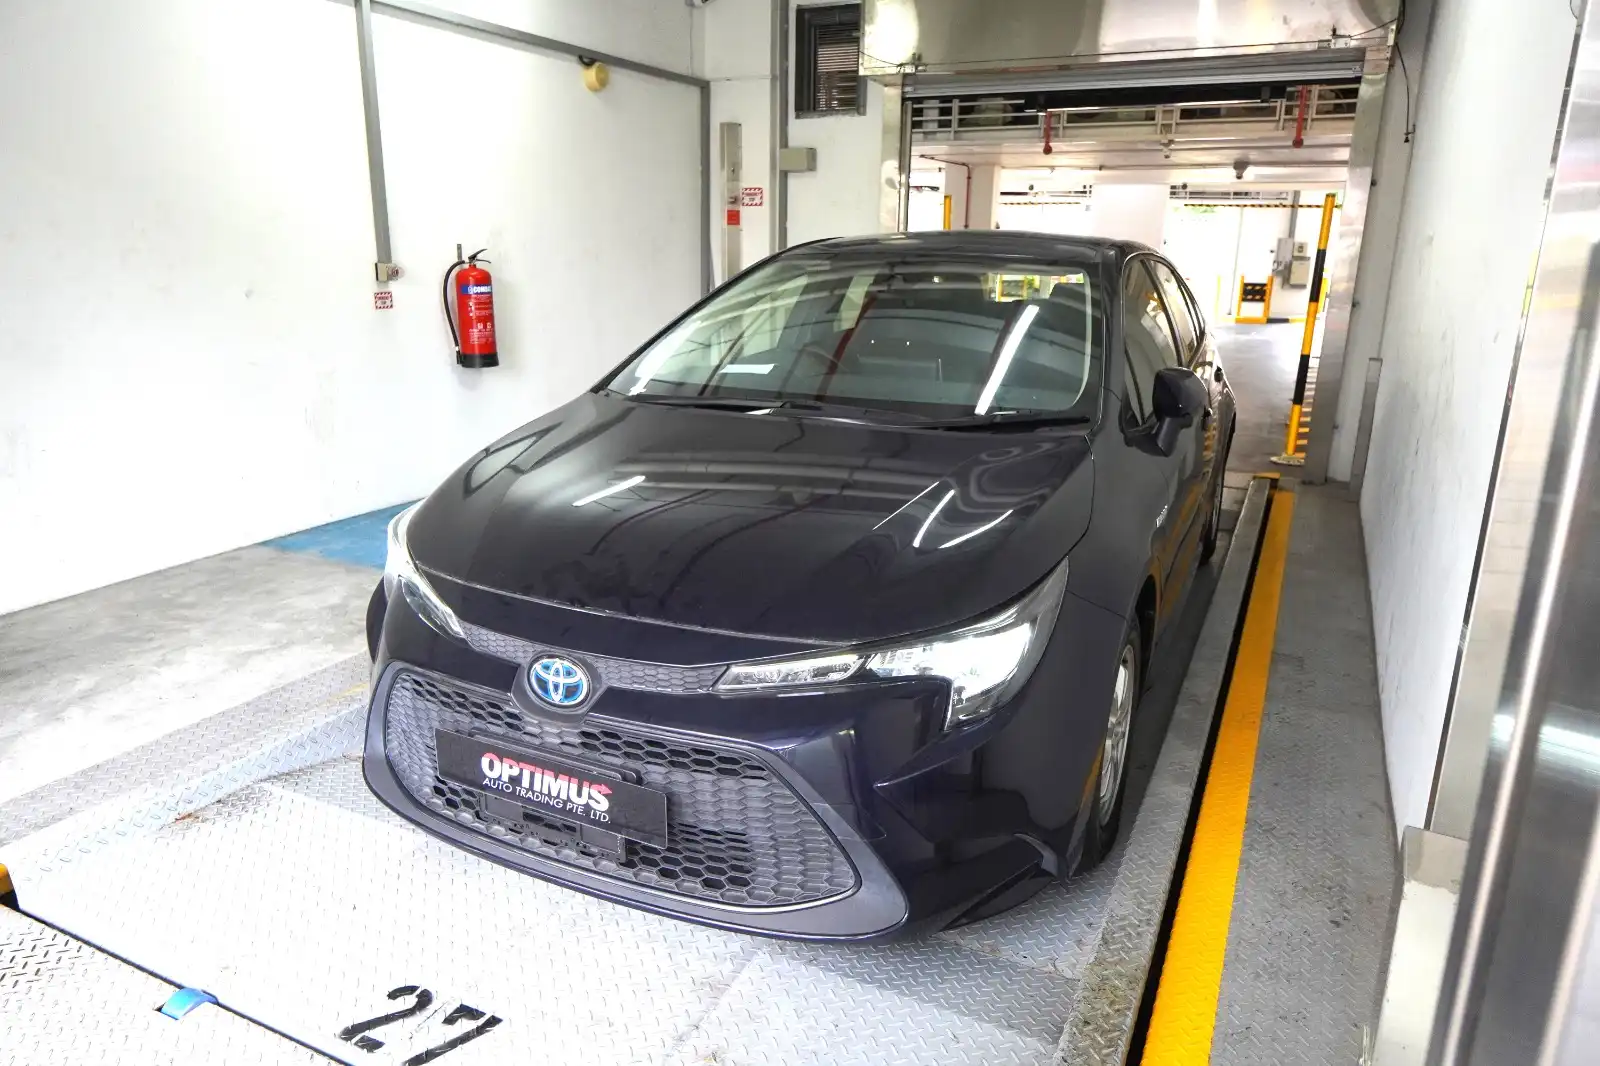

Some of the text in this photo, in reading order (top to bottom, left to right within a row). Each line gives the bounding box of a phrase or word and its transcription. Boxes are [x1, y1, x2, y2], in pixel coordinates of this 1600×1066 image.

[481, 752, 612, 812] OPTIMUS
[483, 778, 611, 824] AUTO TRADING PTE. LTD.
[339, 985, 503, 1066] 27
